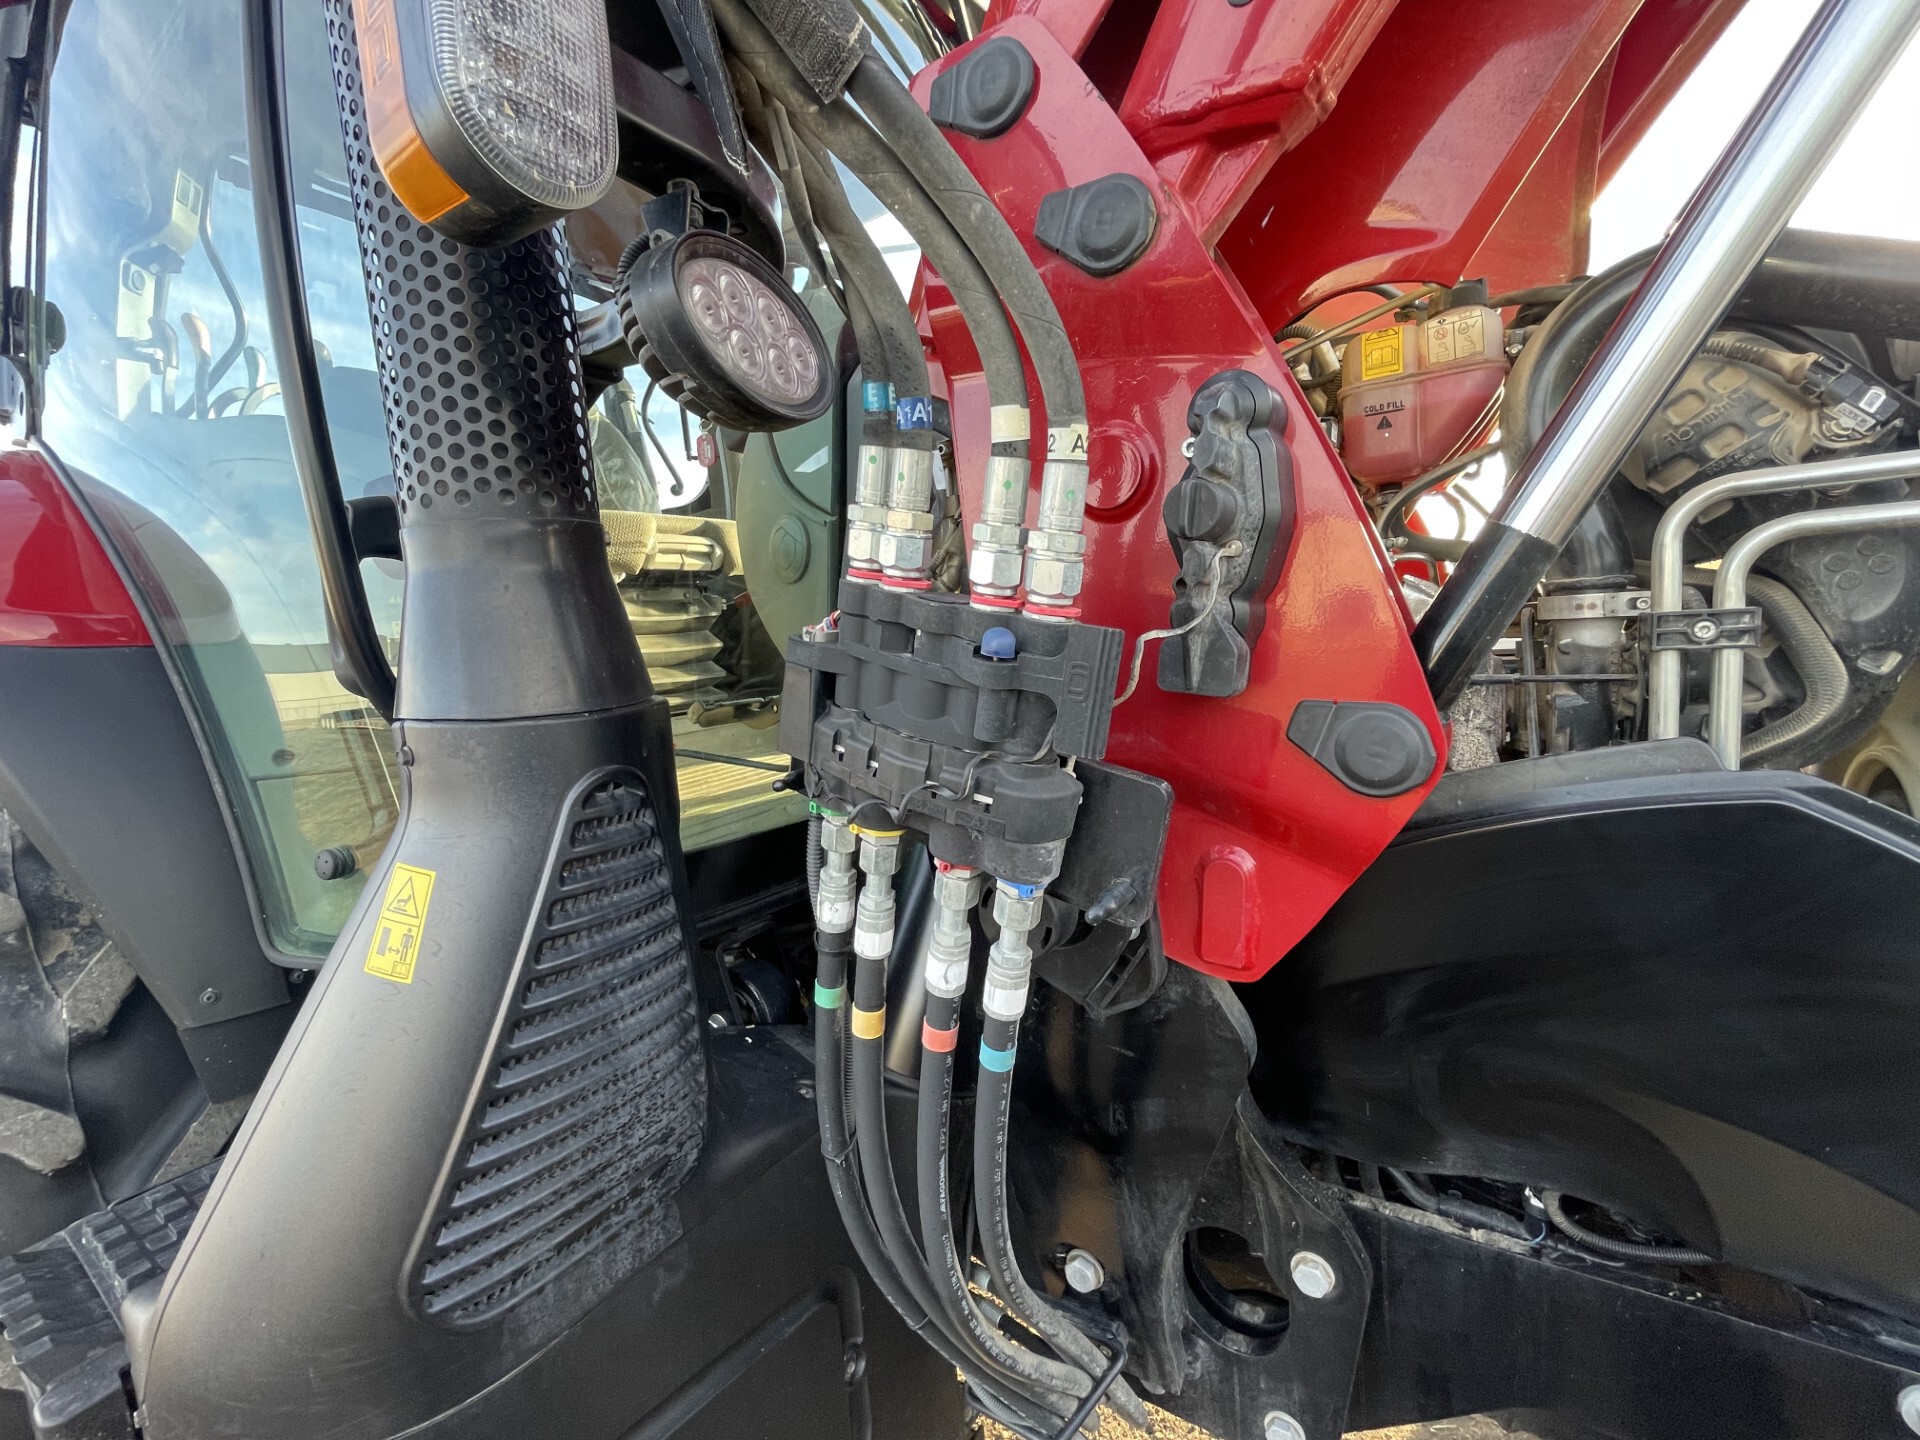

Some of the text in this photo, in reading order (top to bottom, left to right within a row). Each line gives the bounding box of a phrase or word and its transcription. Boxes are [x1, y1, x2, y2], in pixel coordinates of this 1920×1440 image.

[867, 383, 877, 402] E
[912, 402, 933, 423] A1
[1364, 400, 1405, 414] COLD FILL
